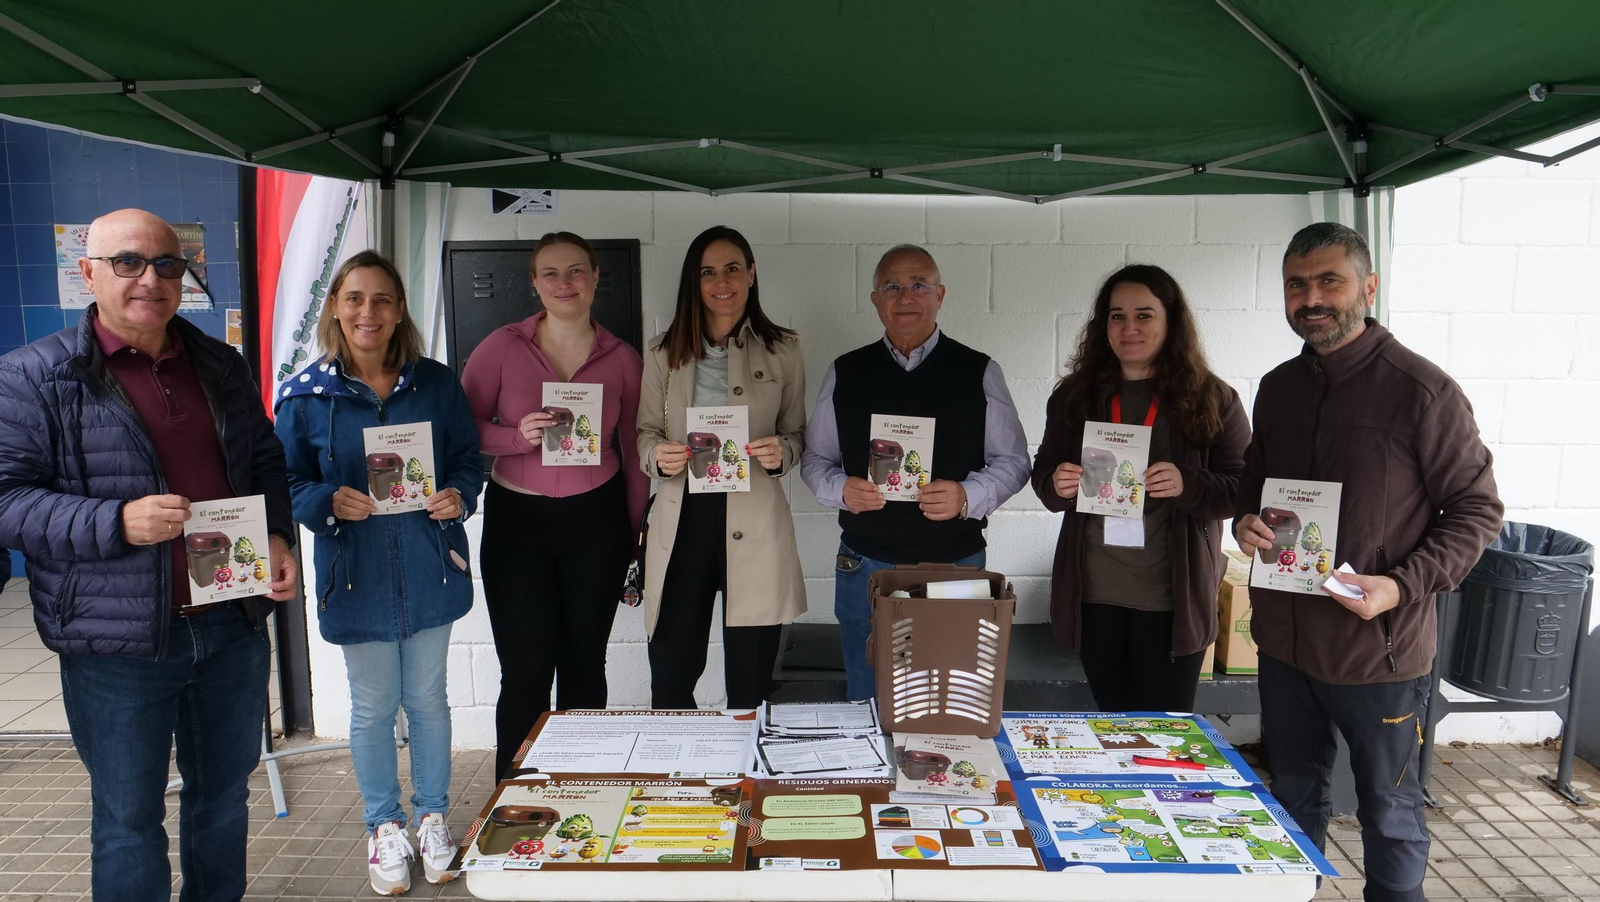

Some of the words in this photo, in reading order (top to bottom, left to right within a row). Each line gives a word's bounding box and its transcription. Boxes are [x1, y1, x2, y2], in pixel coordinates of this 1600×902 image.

[385, 431, 416, 440] contenedor
[1103, 430, 1135, 438] contenedor
[1286, 488, 1322, 497] contenedor
[208, 506, 246, 516] contenedor
